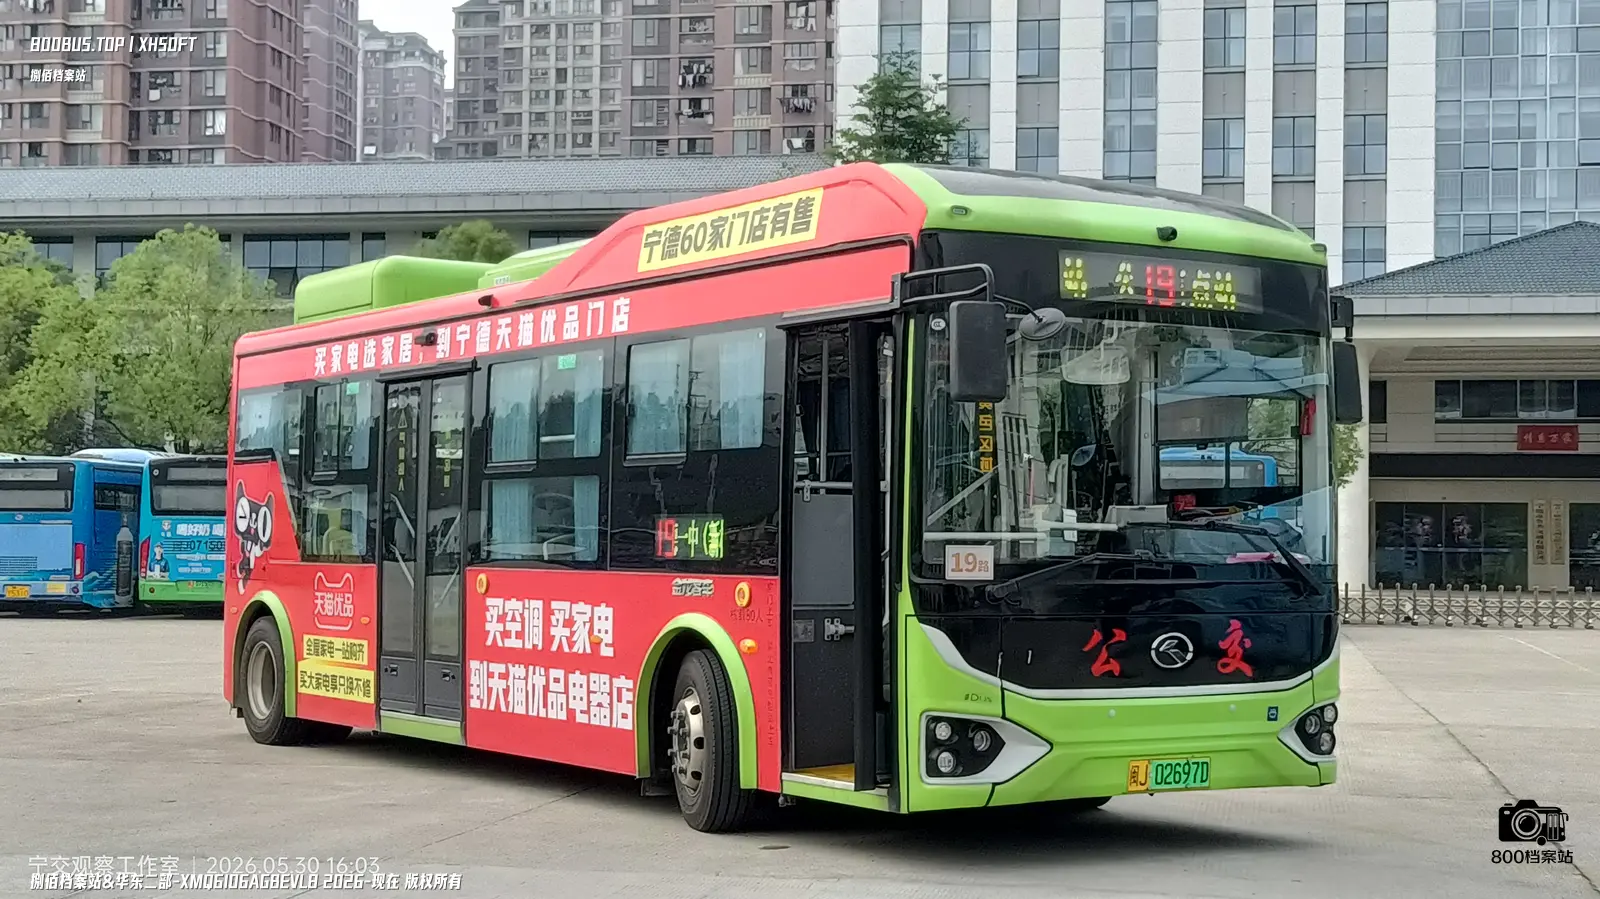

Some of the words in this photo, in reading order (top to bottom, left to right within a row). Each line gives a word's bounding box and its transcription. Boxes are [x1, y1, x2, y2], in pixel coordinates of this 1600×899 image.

[643, 196, 816, 264] 宁德60家门店有售
[314, 592, 354, 617] 天猫优品
[485, 597, 544, 651] 买空调
[550, 600, 615, 657] 买家电
[305, 638, 366, 663] 全屋家电一站购齐
[299, 670, 371, 699] 买大家电享只换不修
[469, 659, 634, 730] 到天猫优品电器店
[1154, 761, 1210, 786] 02697D
